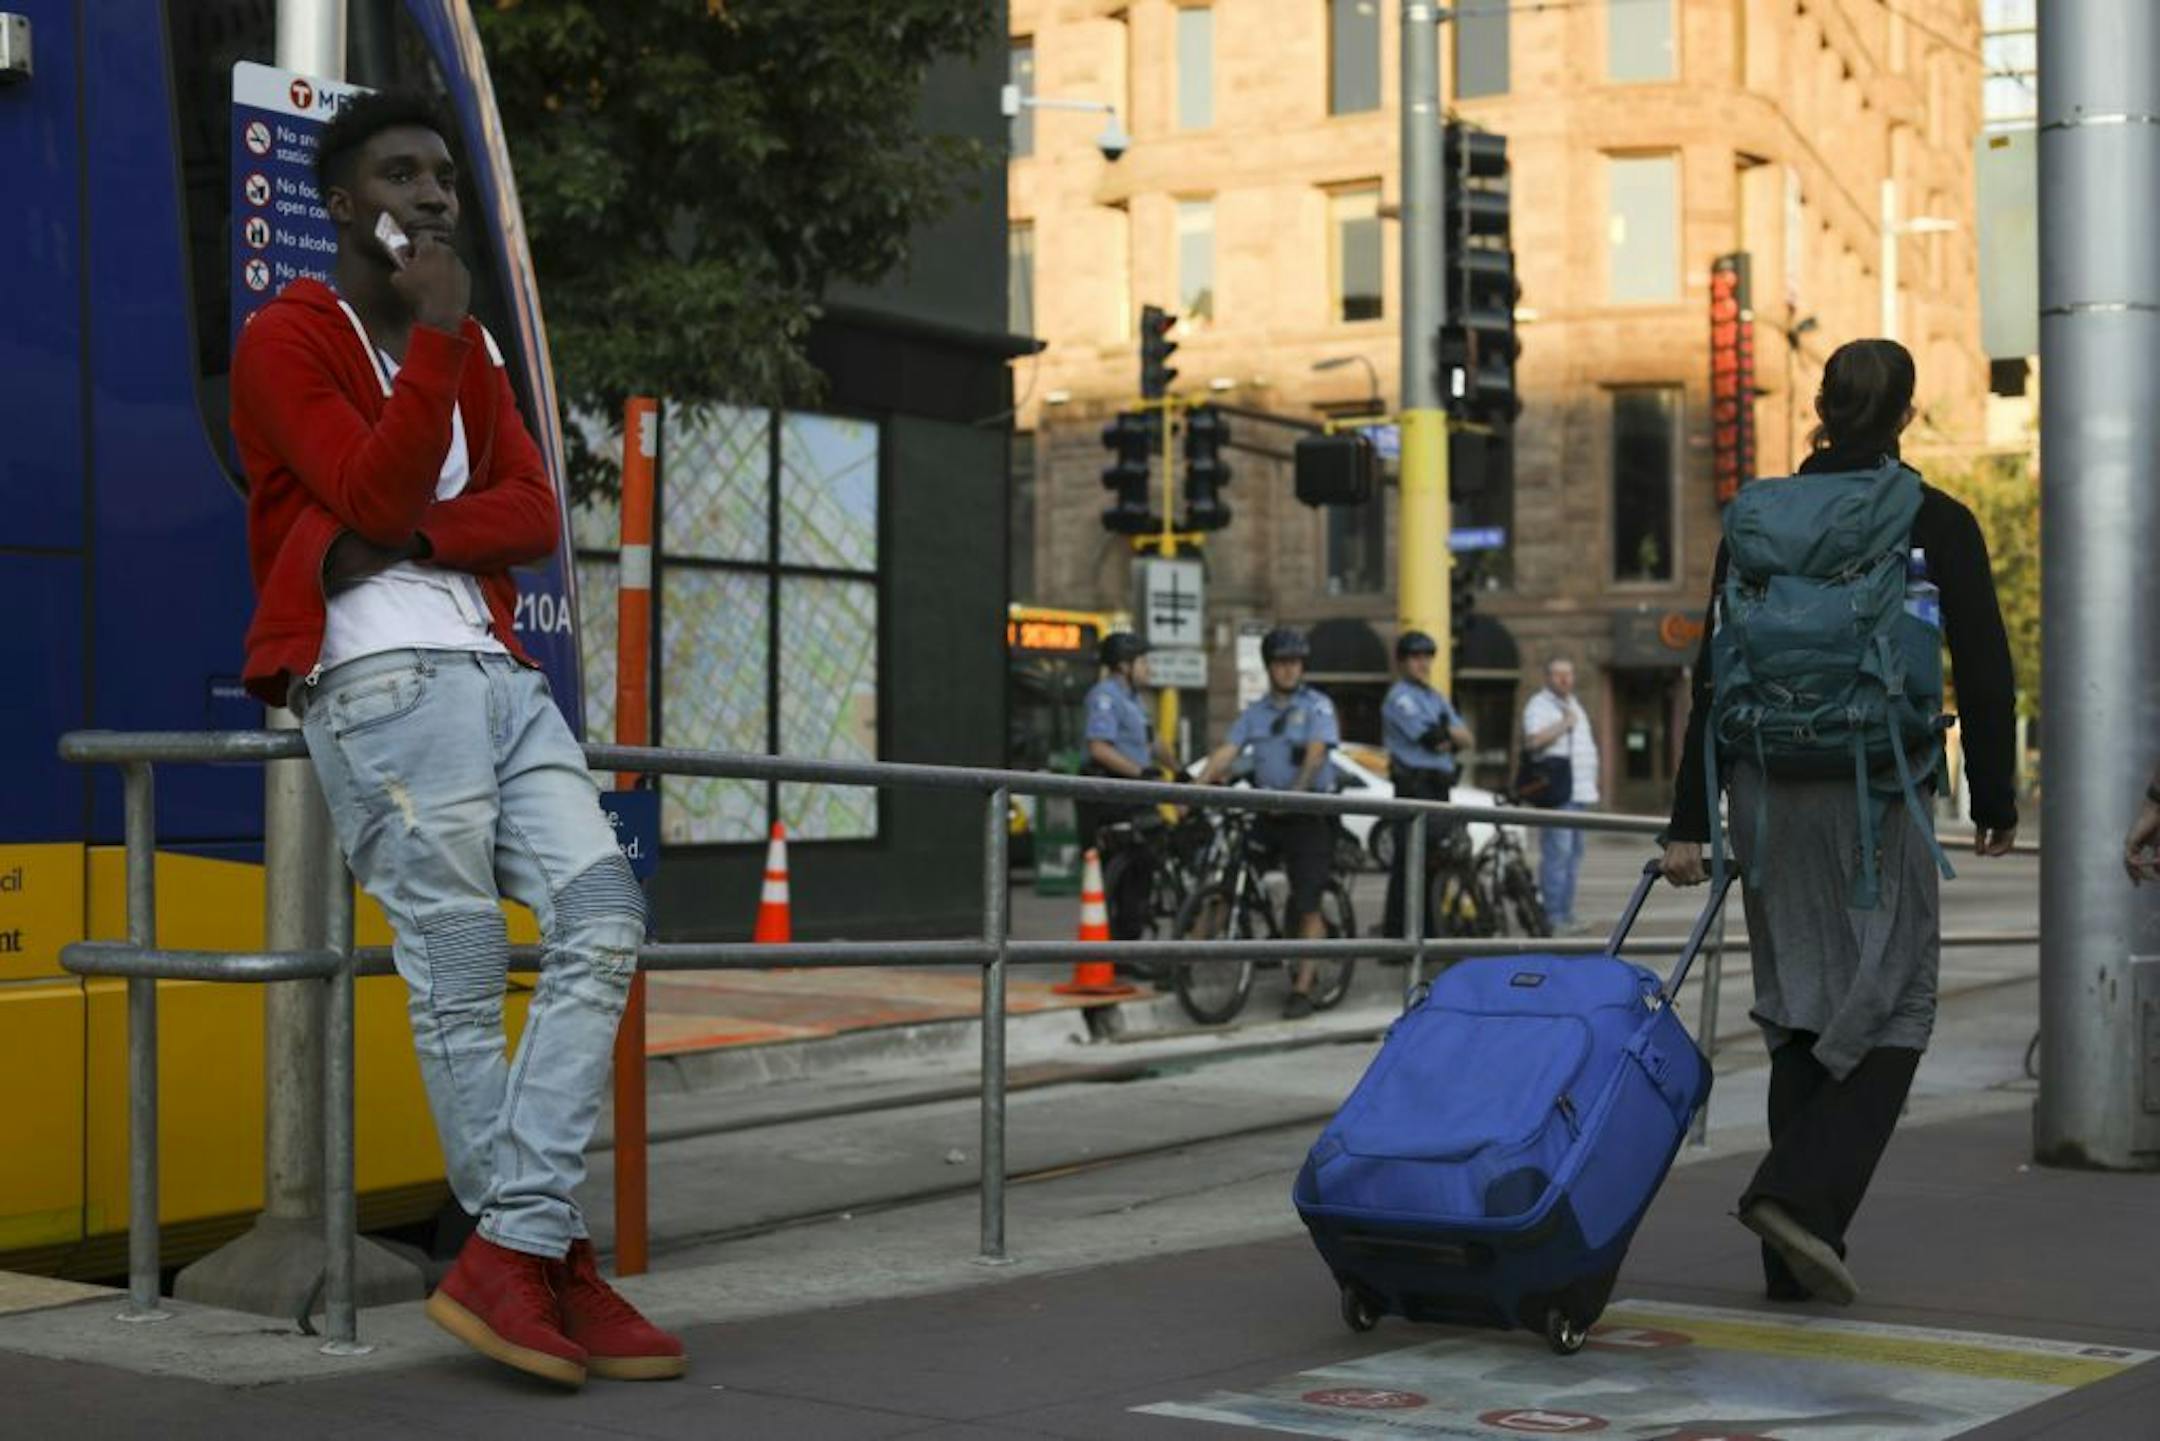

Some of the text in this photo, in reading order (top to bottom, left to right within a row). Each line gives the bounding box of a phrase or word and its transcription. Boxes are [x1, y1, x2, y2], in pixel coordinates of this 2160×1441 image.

[277, 125, 297, 143] No
[276, 178, 296, 195] No
[276, 201, 306, 216] open
[276, 229, 296, 246] No
[276, 262, 296, 279] No
